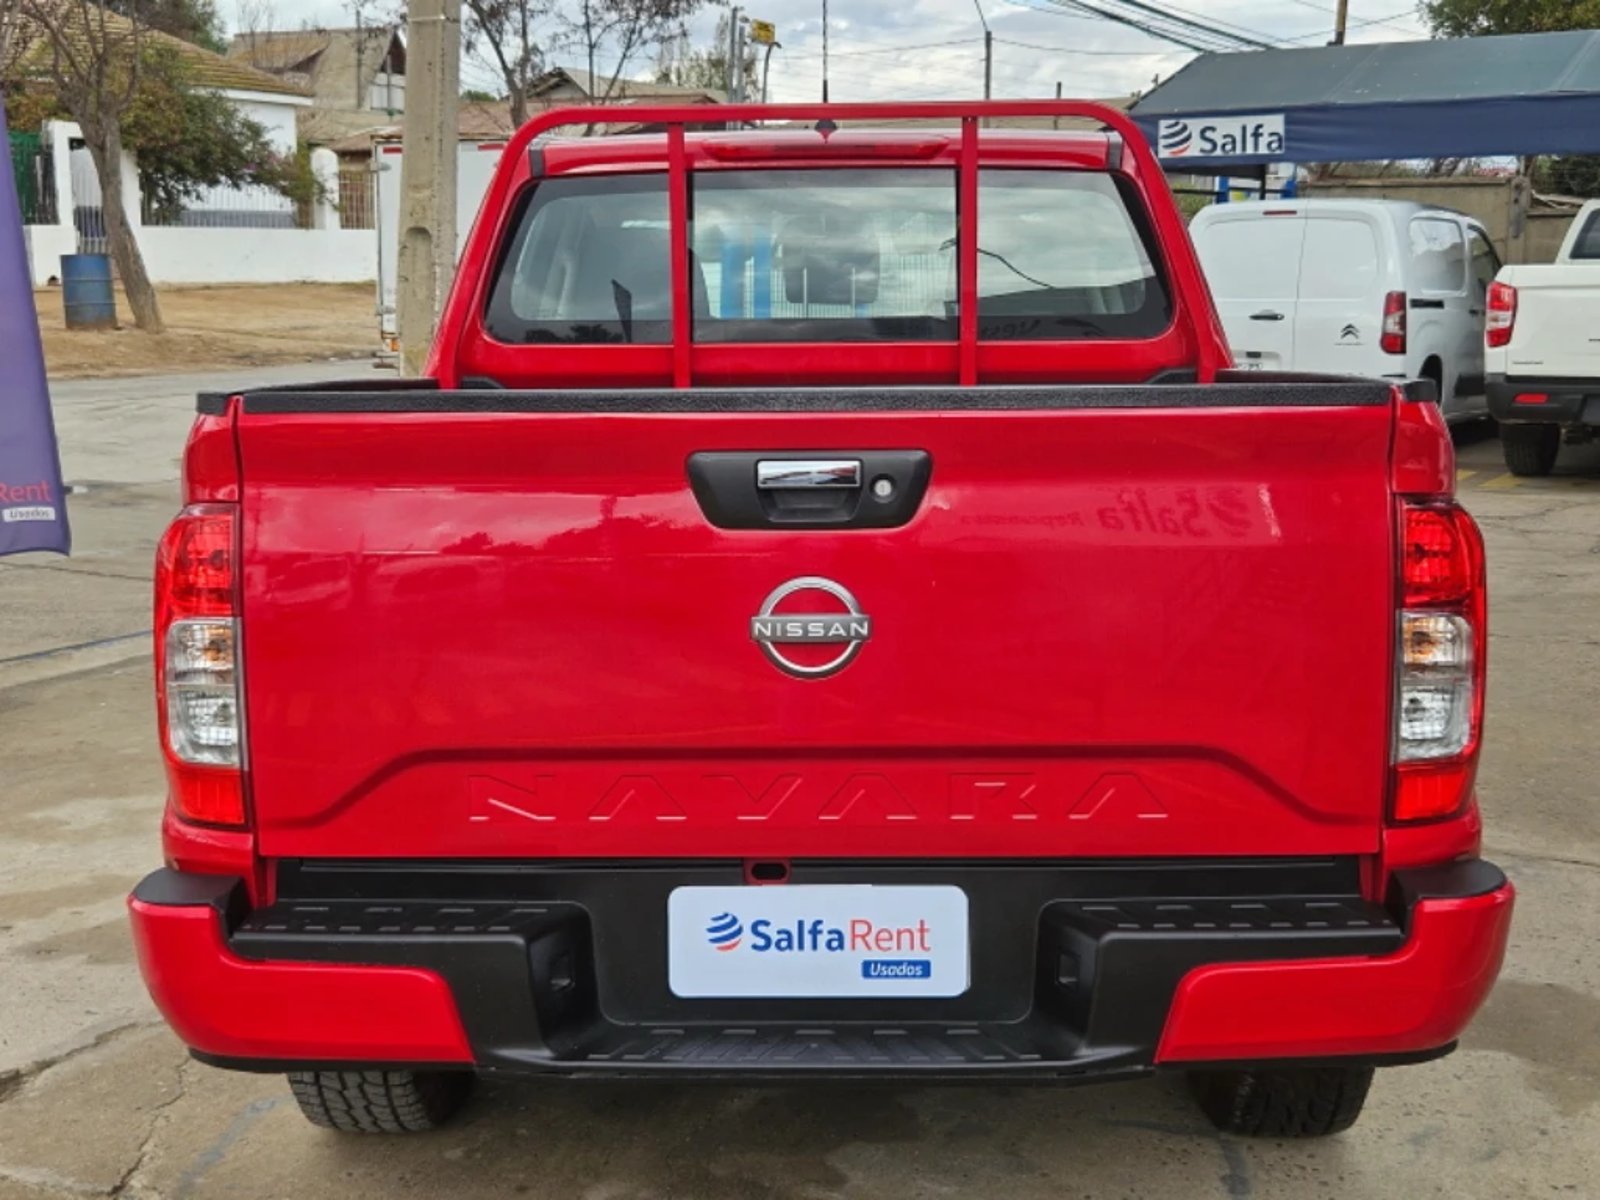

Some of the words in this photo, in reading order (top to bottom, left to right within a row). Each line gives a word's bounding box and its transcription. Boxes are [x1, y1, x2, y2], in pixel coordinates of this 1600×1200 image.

[1199, 123, 1282, 154] Salfa
[754, 622, 868, 637] NISSAN
[467, 772, 1168, 821] NAVARA
[870, 962, 923, 976] Usados
